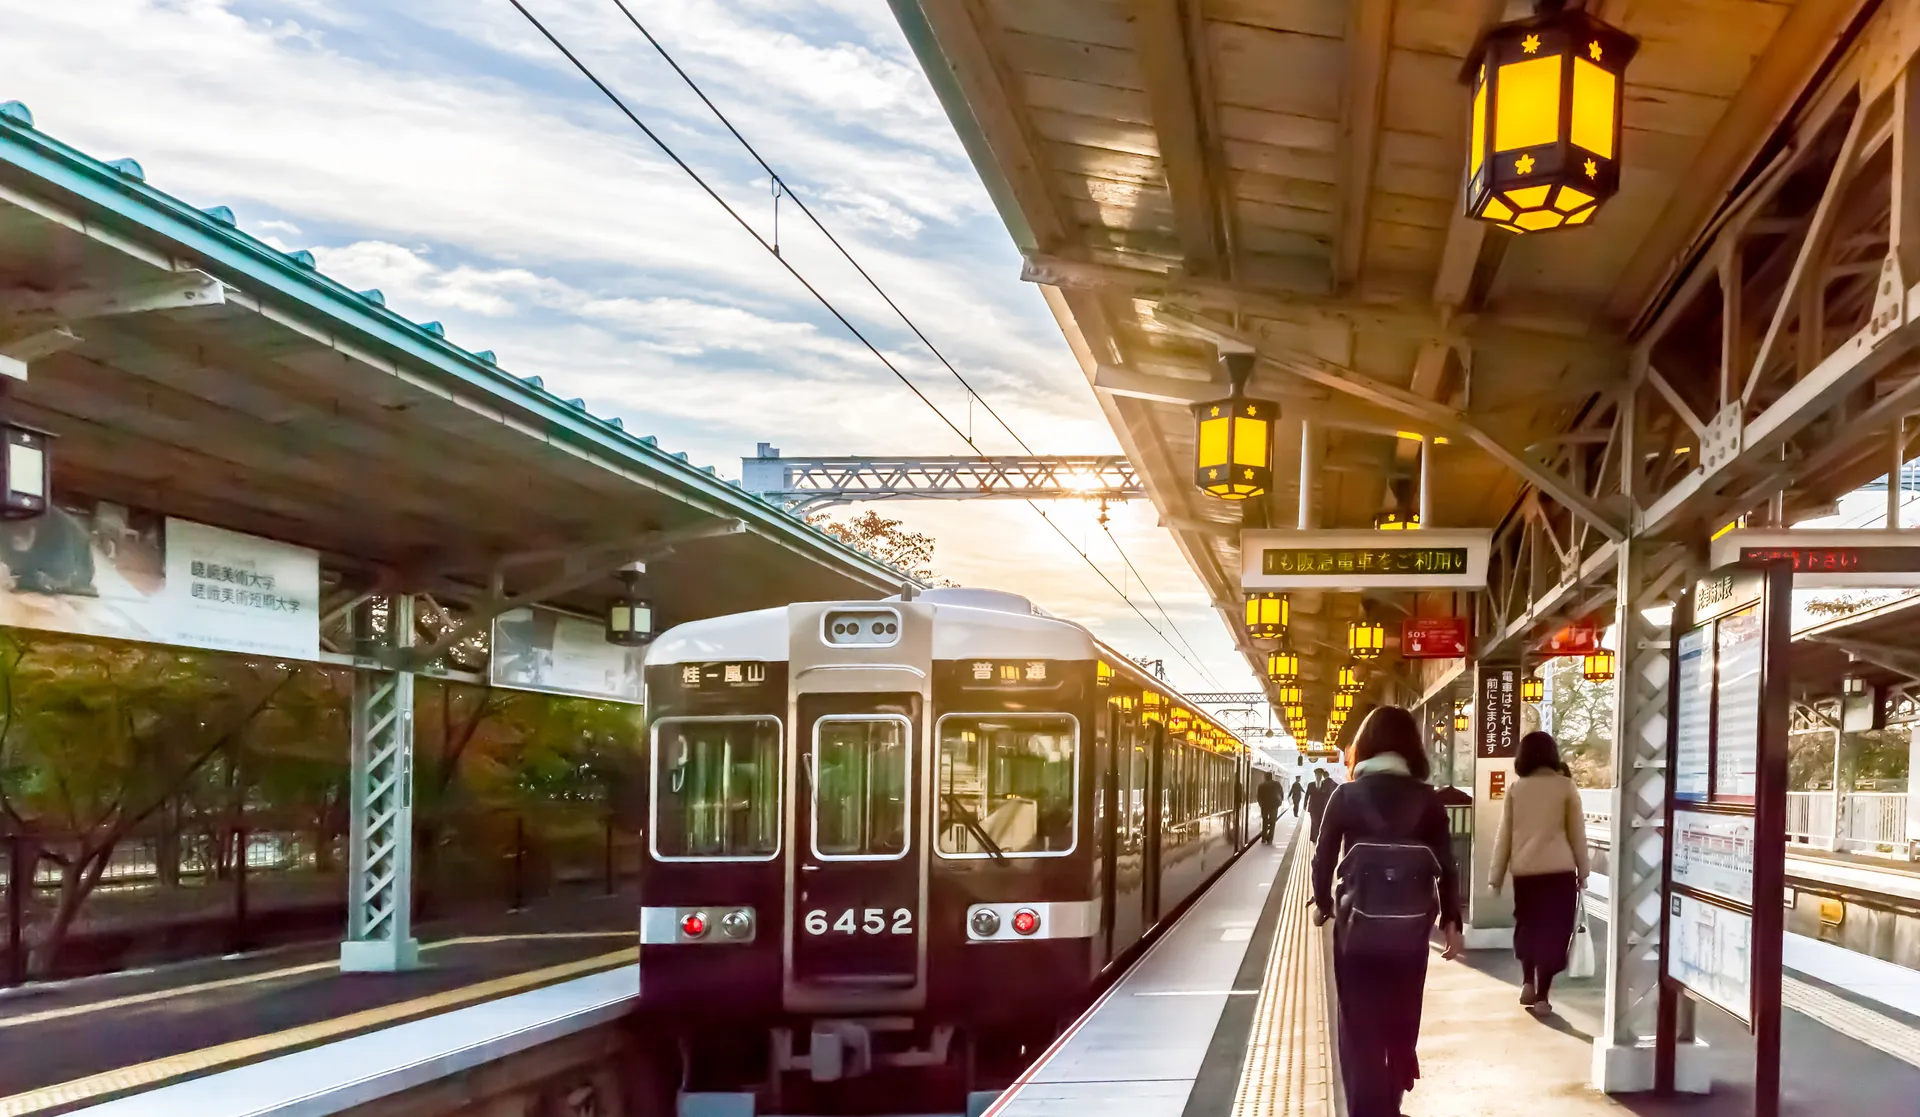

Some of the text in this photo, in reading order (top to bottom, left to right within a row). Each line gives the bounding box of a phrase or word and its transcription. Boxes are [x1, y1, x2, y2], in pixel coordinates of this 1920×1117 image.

[1407, 630, 1426, 639] SOS
[1485, 677, 1498, 755] 前にとまります
[1501, 670, 1514, 748] 電車はこれより
[804, 907, 913, 936] 6452
